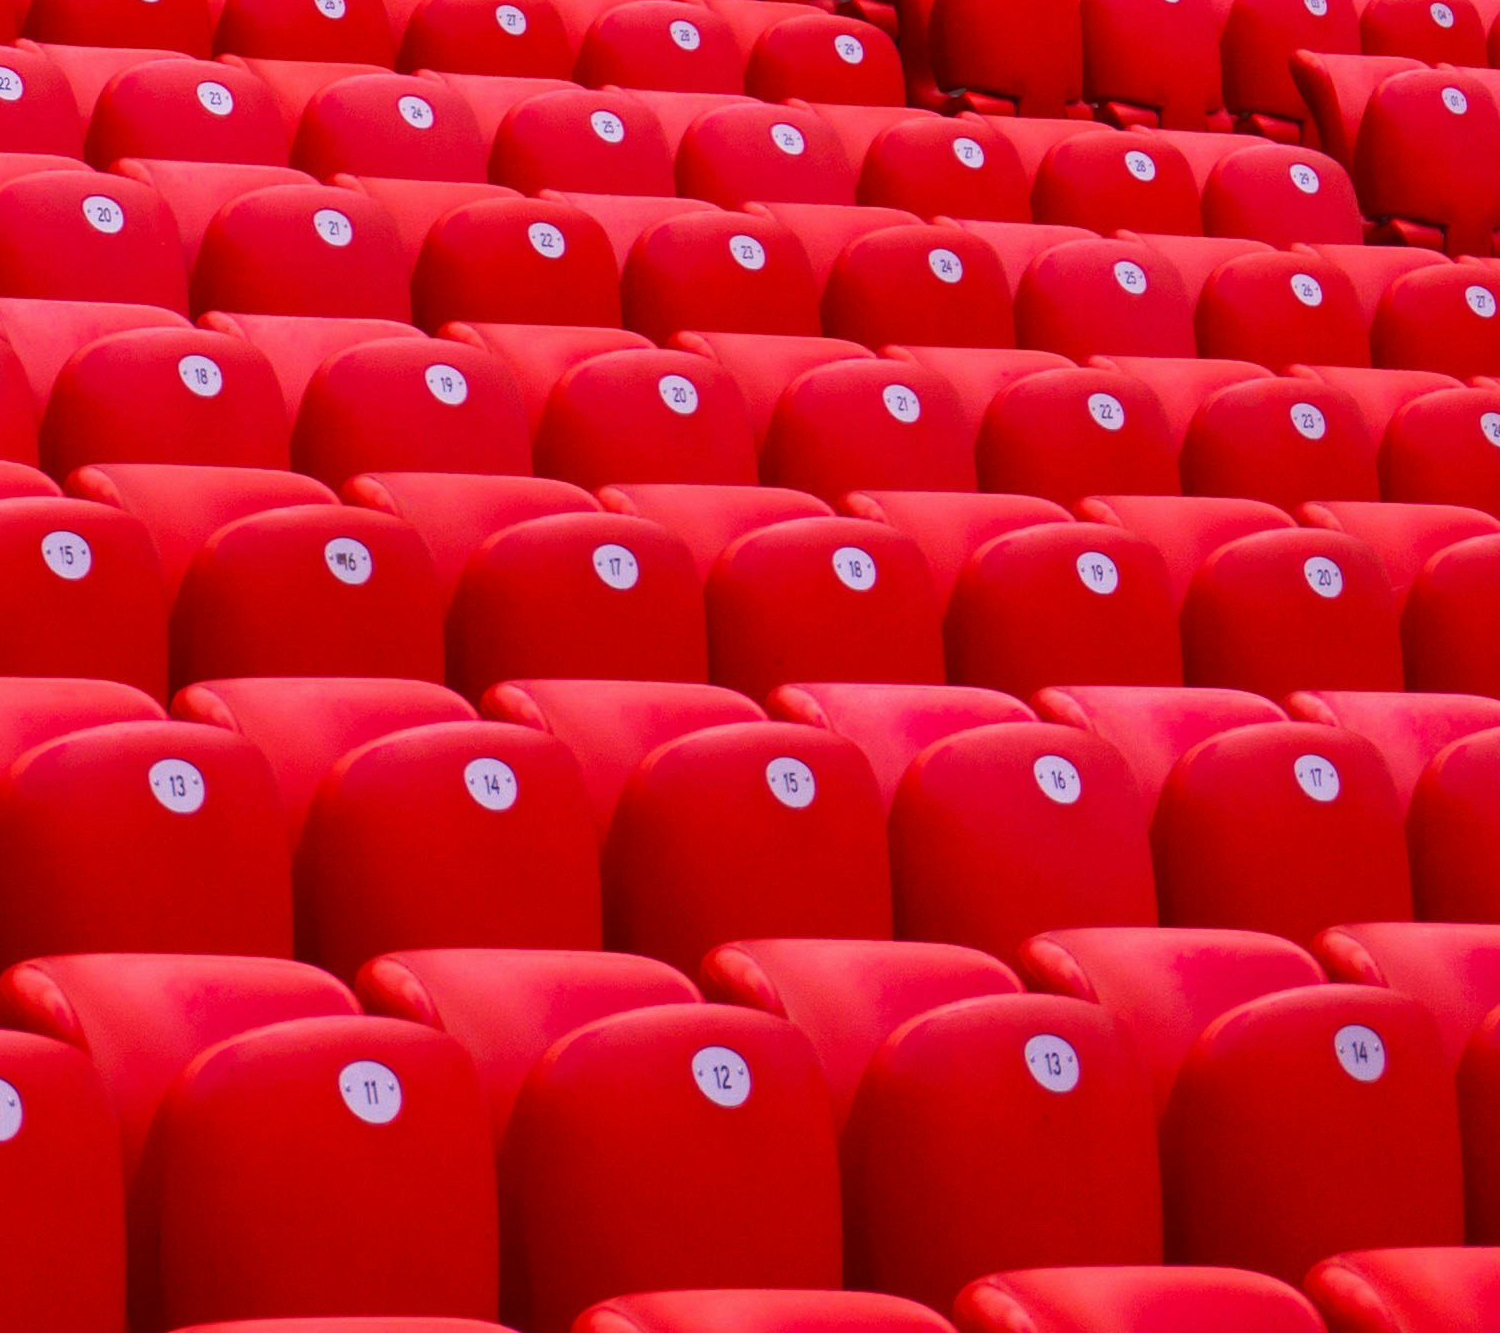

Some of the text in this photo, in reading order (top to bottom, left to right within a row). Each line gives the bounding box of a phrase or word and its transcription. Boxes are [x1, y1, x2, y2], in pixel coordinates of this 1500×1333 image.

[96, 206, 112, 223] 20
[194, 367, 209, 385] 18
[59, 545, 74, 566] 15
[608, 557, 622, 576] 17
[848, 560, 863, 579] 18
[1091, 564, 1104, 582] 19
[1316, 568, 1332, 587] 20
[169, 774, 186, 798] 13
[483, 774, 501, 795] 14
[783, 772, 799, 794] 15
[1051, 770, 1067, 790] 16
[1309, 767, 1322, 787] 17
[1351, 1041, 1369, 1064] 14
[1044, 1052, 1062, 1076] 13
[713, 1064, 733, 1090] 12
[363, 1080, 379, 1106] 11
